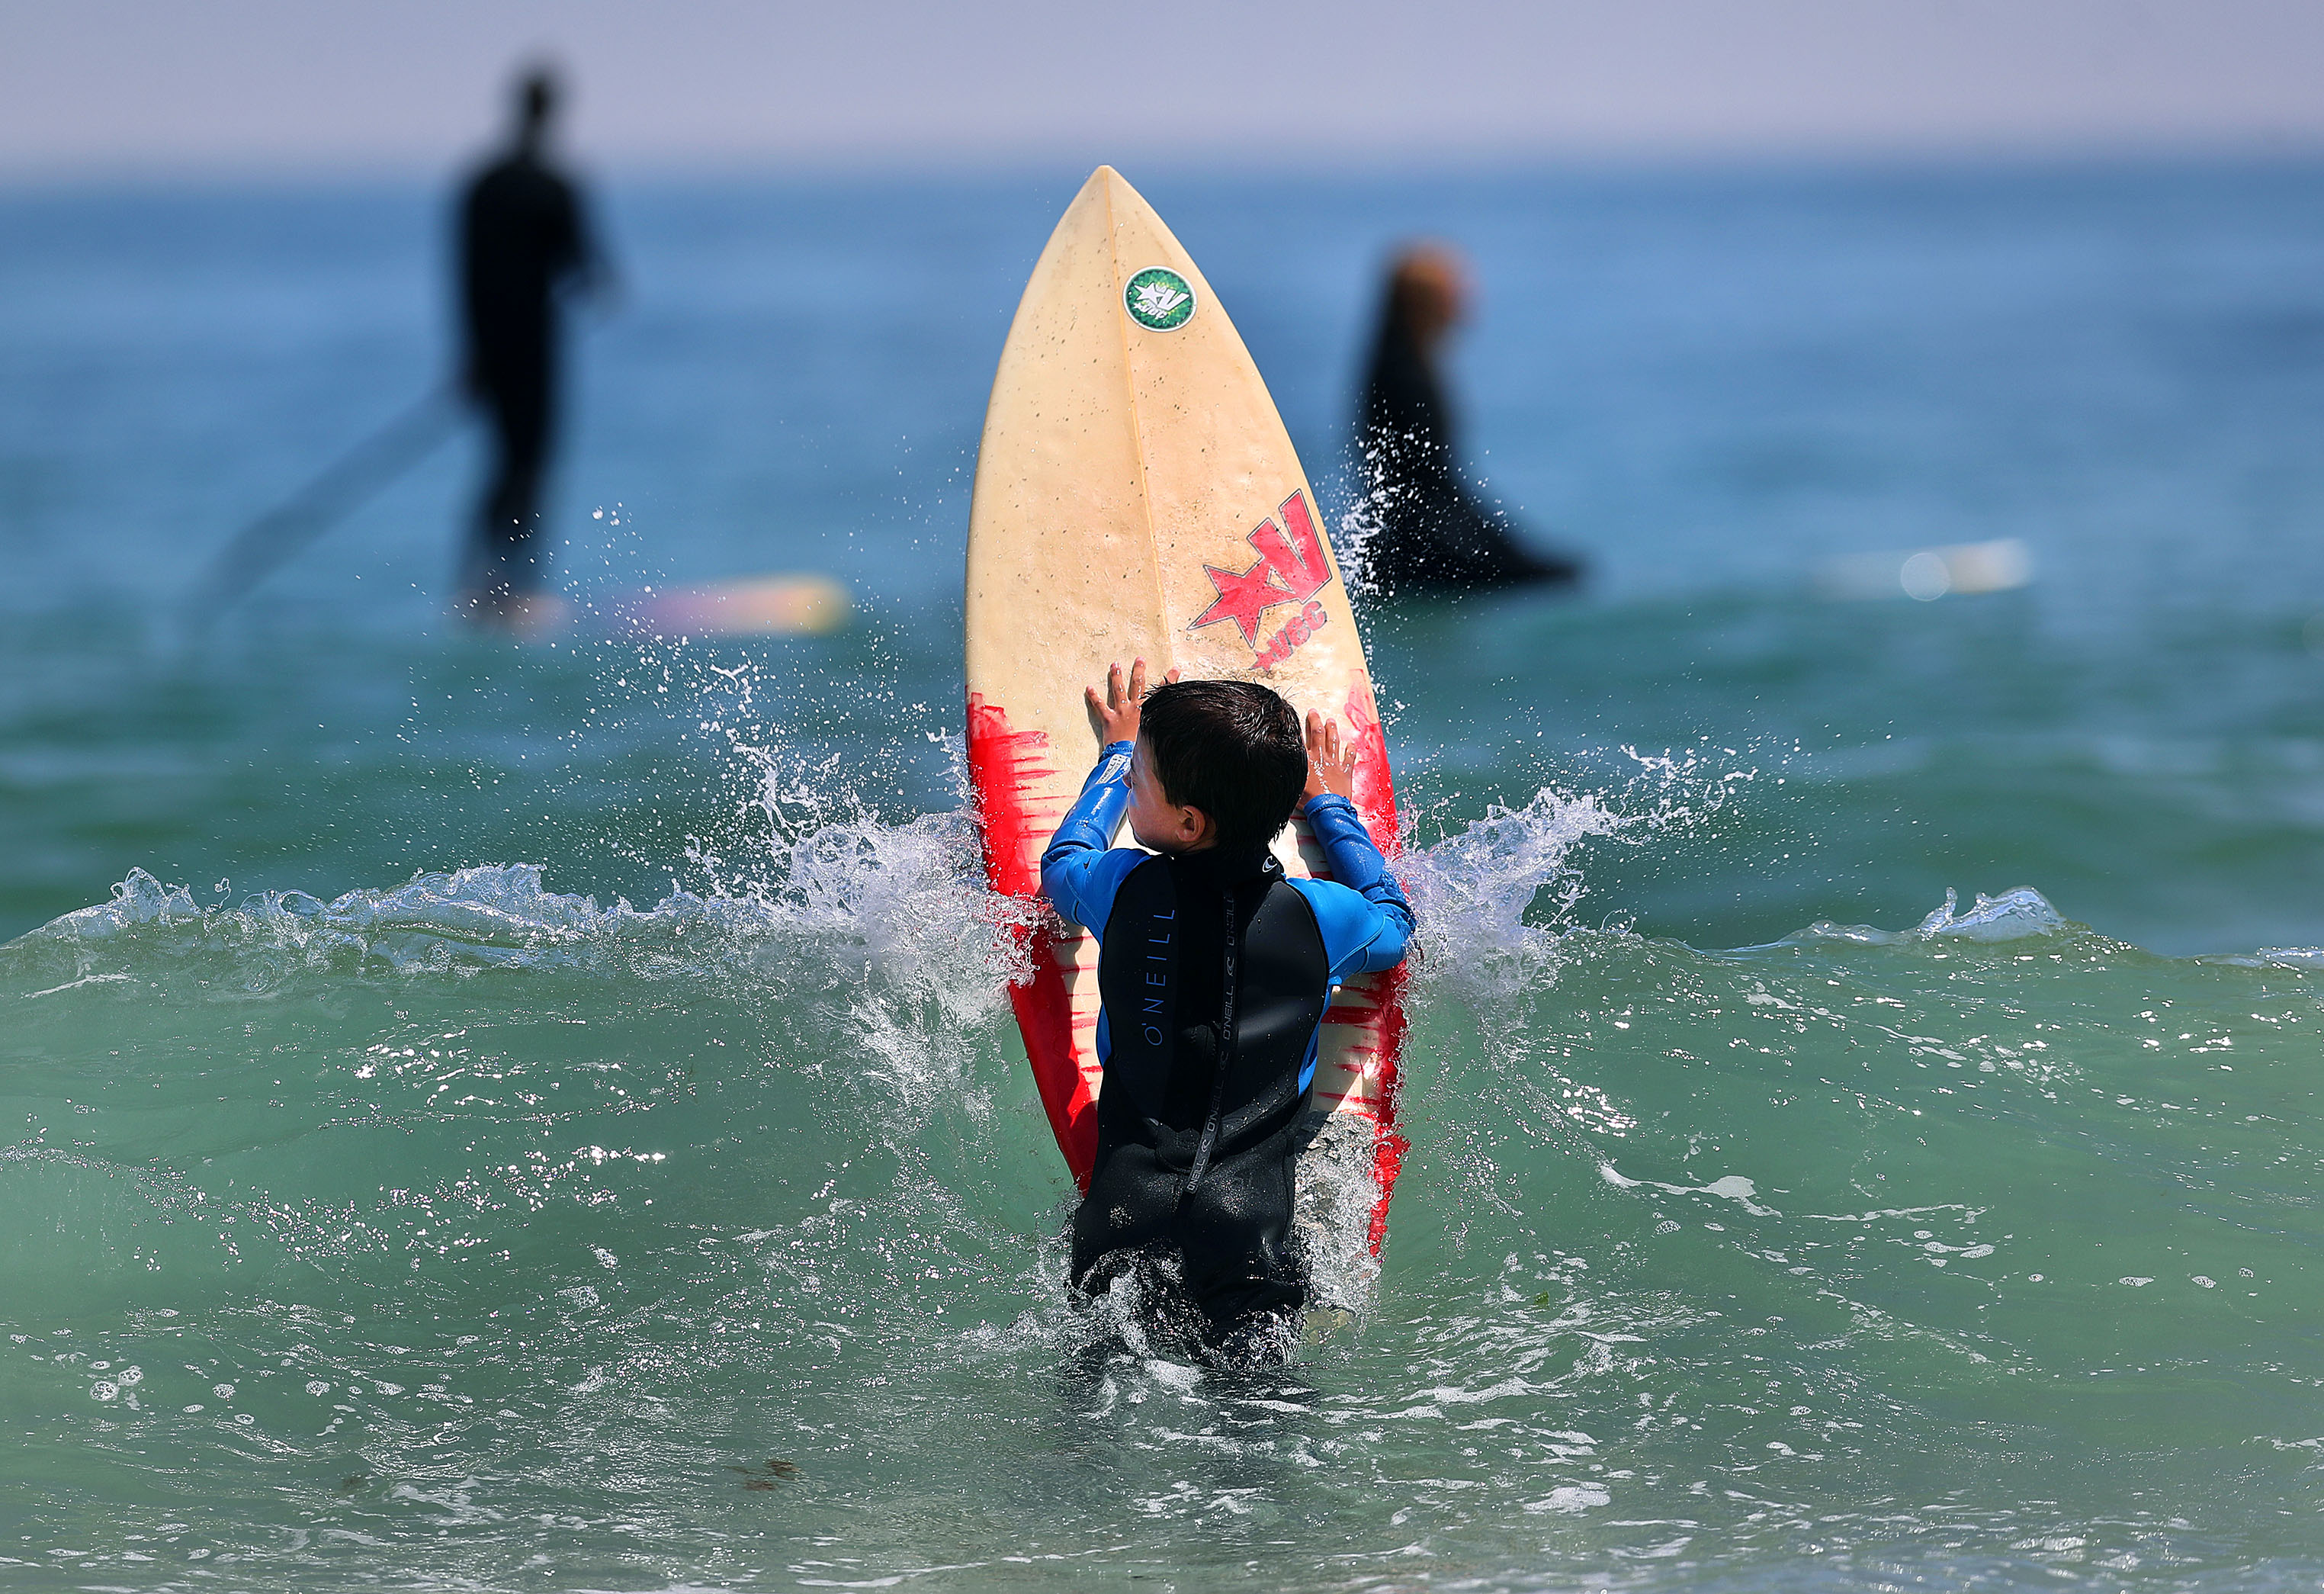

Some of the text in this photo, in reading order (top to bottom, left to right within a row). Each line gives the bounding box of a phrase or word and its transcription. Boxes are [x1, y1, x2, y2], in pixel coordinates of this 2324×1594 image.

[1141, 910, 1175, 1045] O'NEILL
[1222, 985, 1234, 1040] O'NEILL
[1206, 1080, 1225, 1133] O'NEILL
